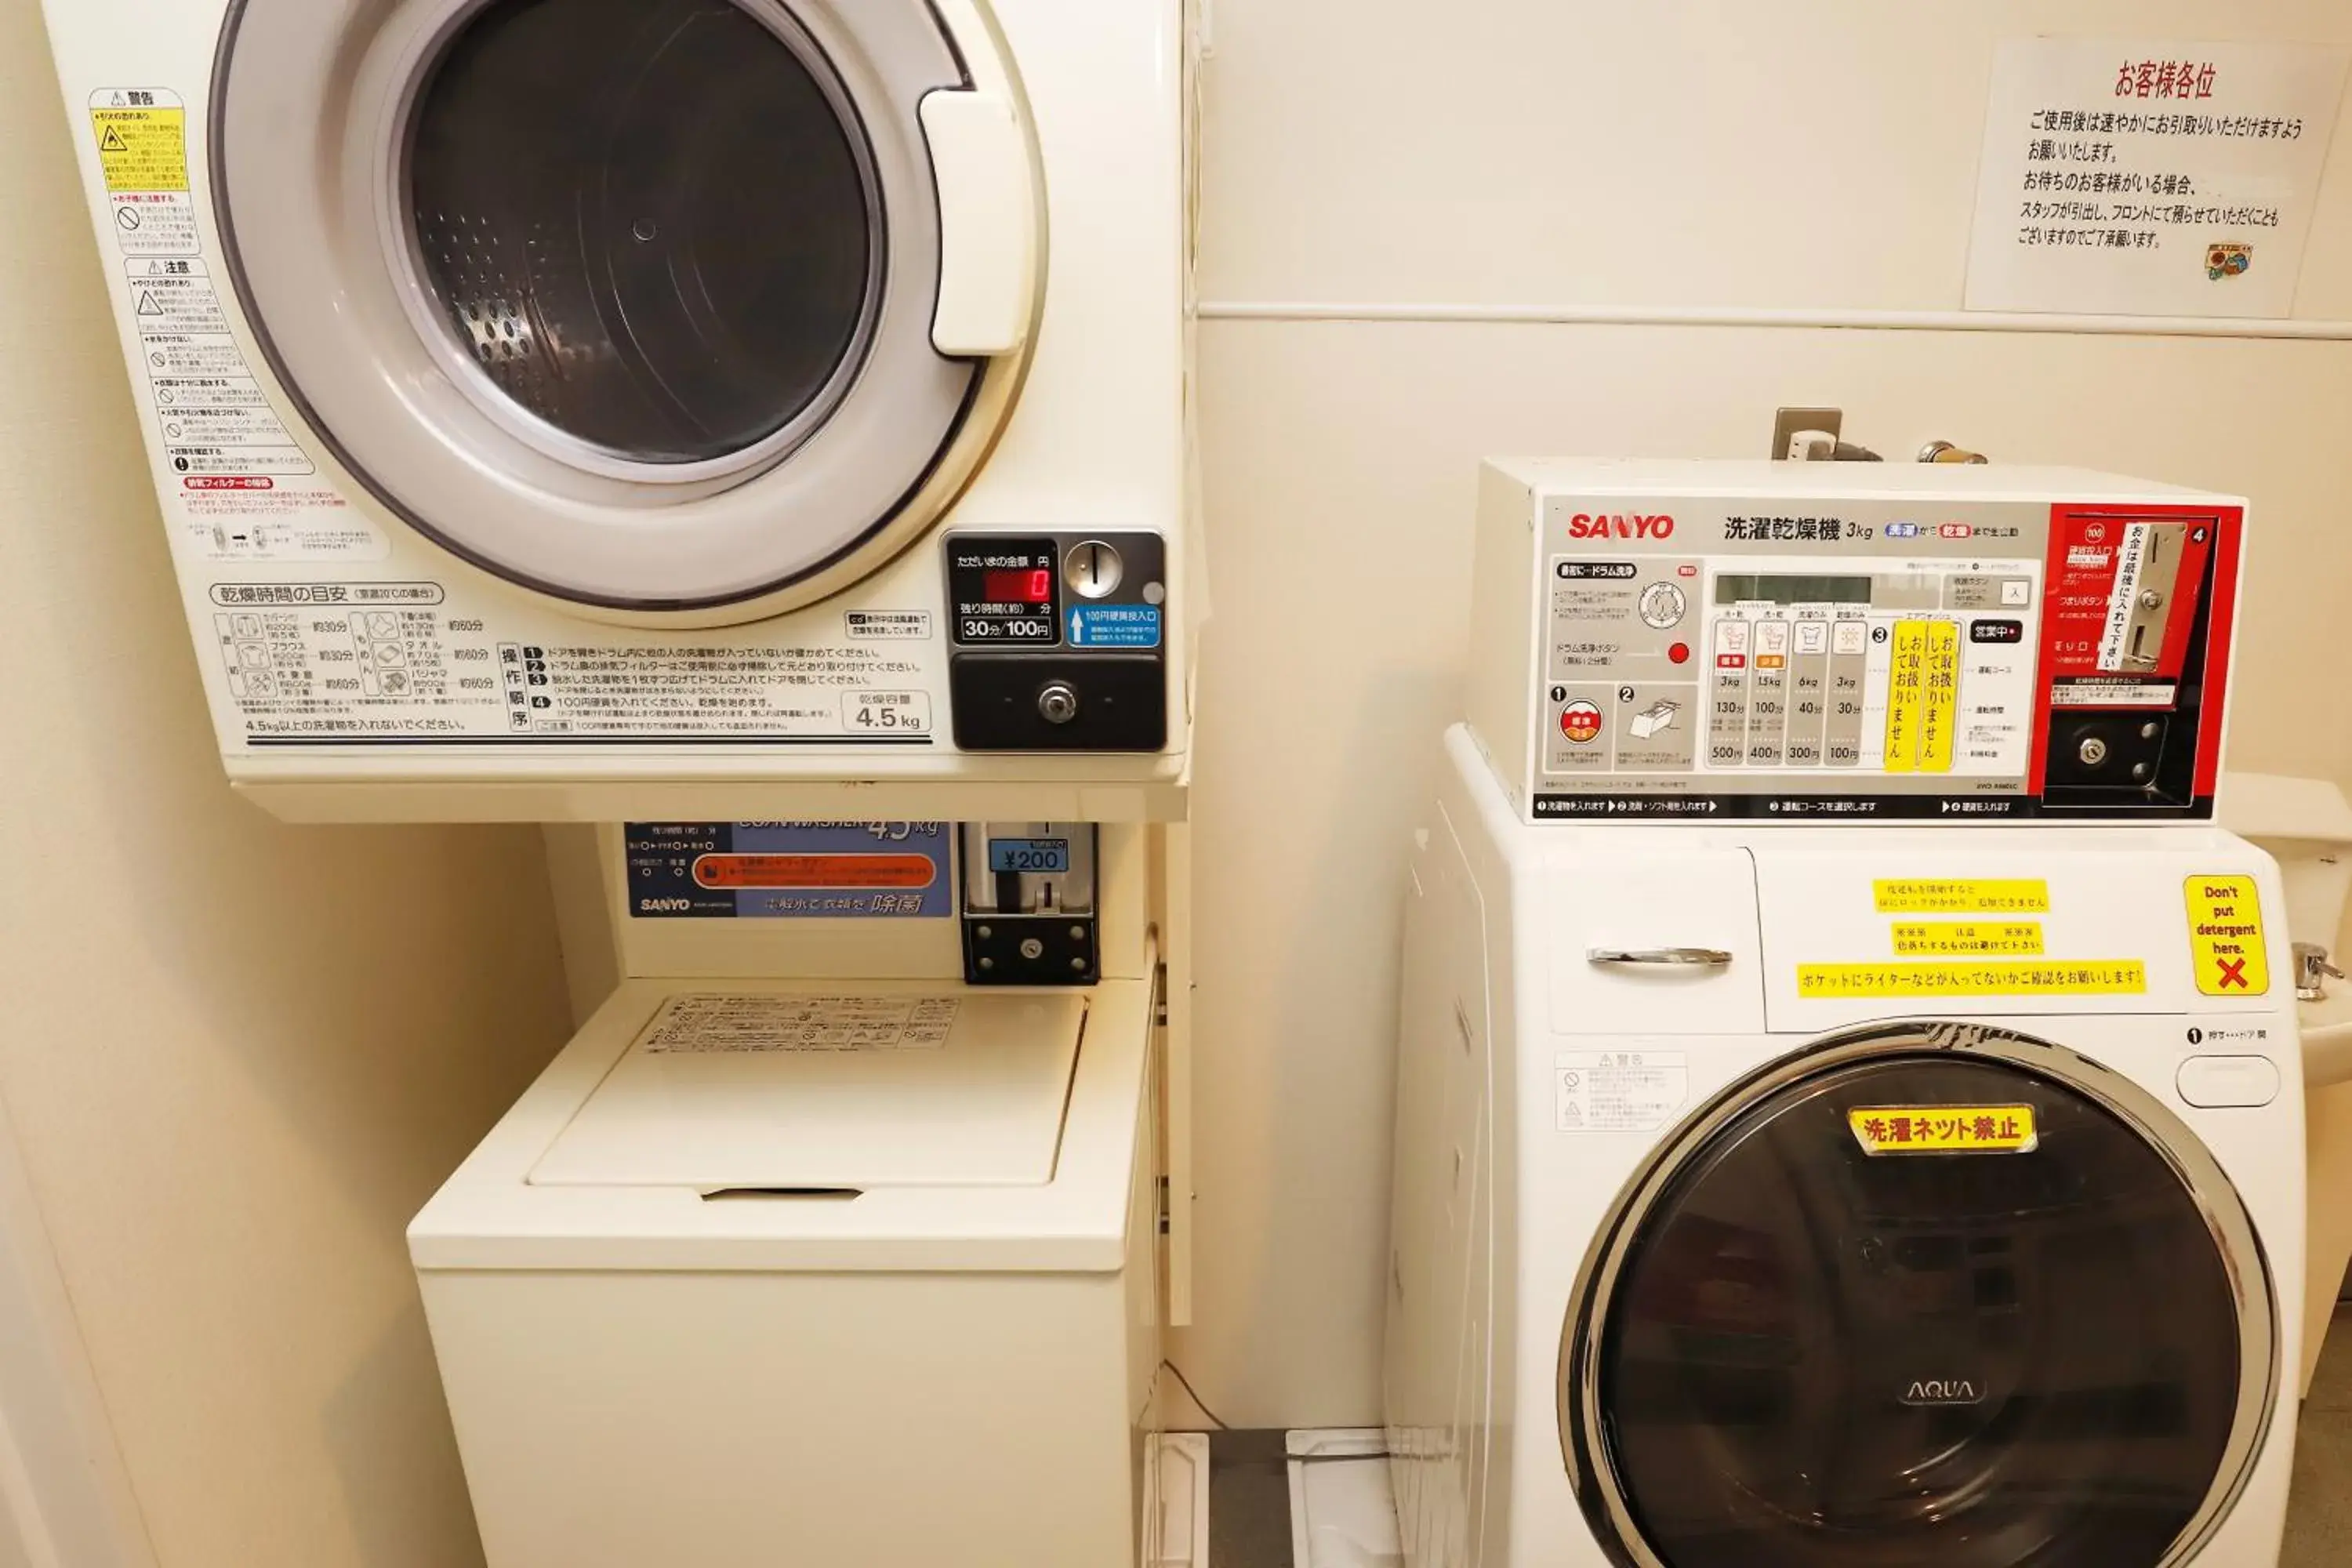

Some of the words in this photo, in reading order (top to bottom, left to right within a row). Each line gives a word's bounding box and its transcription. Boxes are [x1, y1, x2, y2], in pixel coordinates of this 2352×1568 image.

[2115, 60, 2216, 100] お客様各位
[128, 91, 154, 105] 警告
[2031, 111, 2303, 140] ご使用後は速やかにお引取りいただけますよう
[2028, 139, 2117, 163] お願いいたします。
[2024, 170, 2196, 196] お待ちのお客様がいる場合、
[2020, 201, 2279, 227] スタッフが引出し、フロントにて預らせていただくことも
[2019, 227, 2161, 249] ございますのでご了承願います。
[165, 260, 190, 274] 注意
[1569, 514, 1675, 539] SANYO
[1725, 517, 1840, 541] 洗濯乾燥機
[1846, 522, 1874, 540] 3kg
[957, 556, 1029, 567] ただいまの金額
[1038, 556, 1049, 567] 円
[1032, 571, 1049, 596] 0
[220, 586, 348, 603] 乾燥時間の目安
[2105, 526, 2144, 667] お金は最後に入れて下さい
[1041, 604, 1051, 615] 分
[1975, 626, 2007, 637] 営業中
[502, 648, 528, 727] 操作順序
[1889, 637, 1907, 759] しておりません
[1924, 637, 1940, 759] しておりません
[856, 708, 896, 728] 4.5
[902, 714, 920, 729] kg
[1712, 746, 1743, 760] 500円
[1750, 746, 1781, 760] 400円
[1789, 746, 1820, 760] 300円
[1830, 746, 1859, 760] 100円
[1004, 851, 1058, 869] ¥200
[2205, 887, 2238, 898] Don't
[641, 899, 691, 911] SANYO
[2213, 906, 2234, 918] put
[2197, 923, 2257, 938] detergent
[2213, 942, 2245, 954] here.
[1907, 1380, 1974, 1399] AQUA
